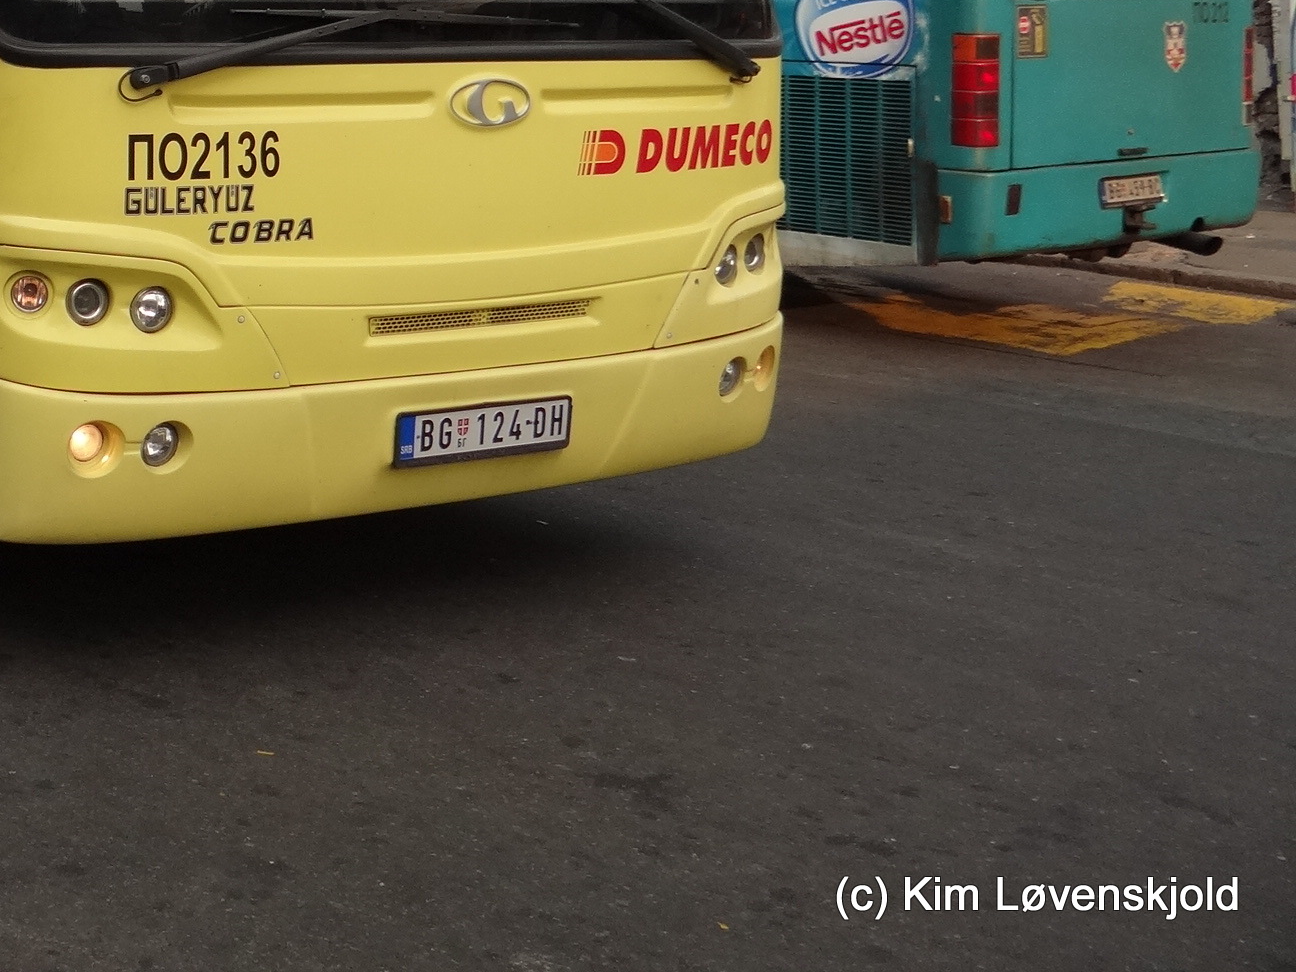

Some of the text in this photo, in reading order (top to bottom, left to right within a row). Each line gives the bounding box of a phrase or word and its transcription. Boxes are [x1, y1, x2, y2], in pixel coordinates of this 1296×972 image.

[635, 119, 773, 174] DUMECO
[208, 217, 314, 245] COBRA
[420, 417, 453, 452] BG
